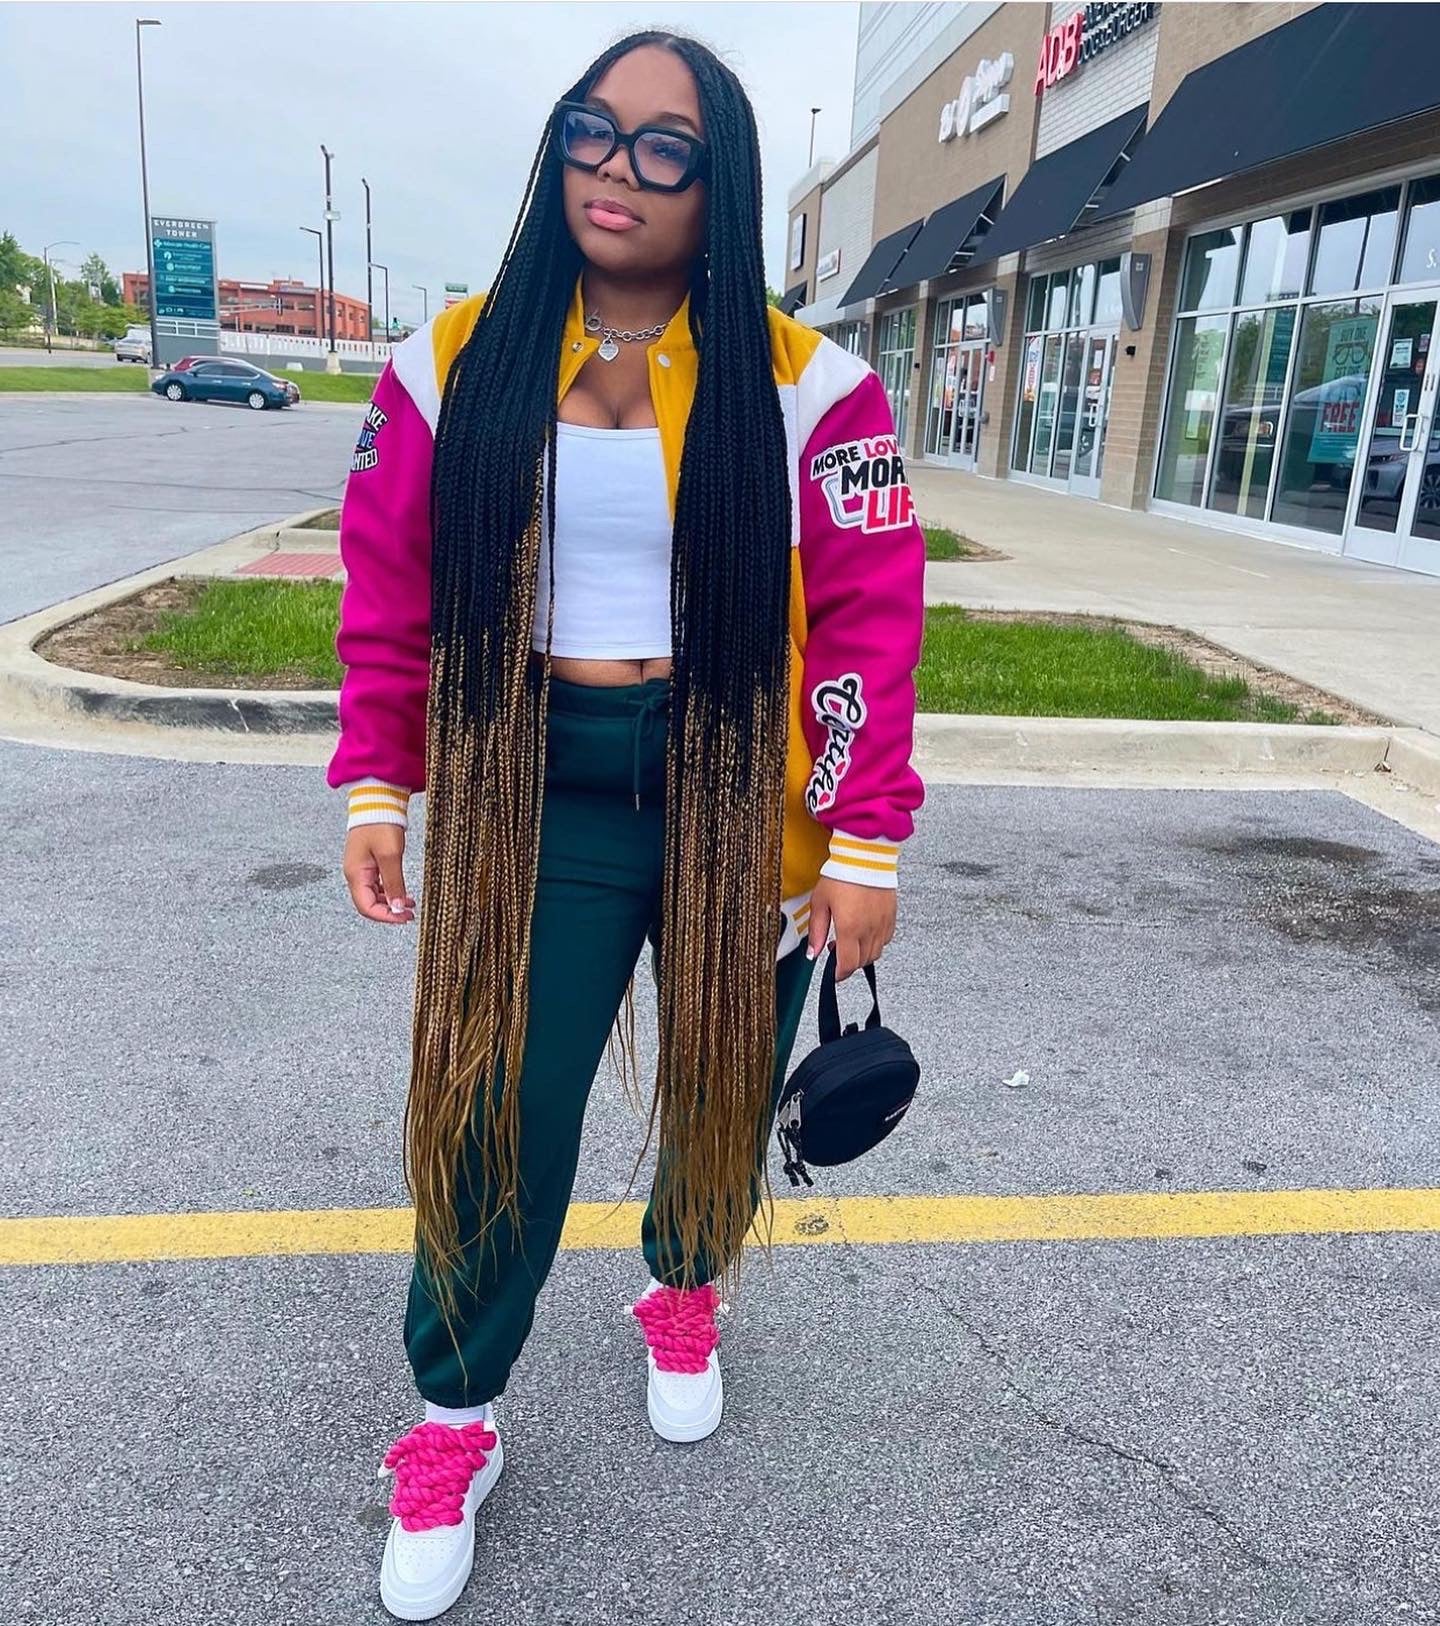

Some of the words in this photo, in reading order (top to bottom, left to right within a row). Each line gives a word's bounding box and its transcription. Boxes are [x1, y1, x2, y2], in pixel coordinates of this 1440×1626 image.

[153, 219, 209, 230] EVERGREEN
[1321, 402, 1360, 433] FREE
[812, 445, 861, 477] MORE
